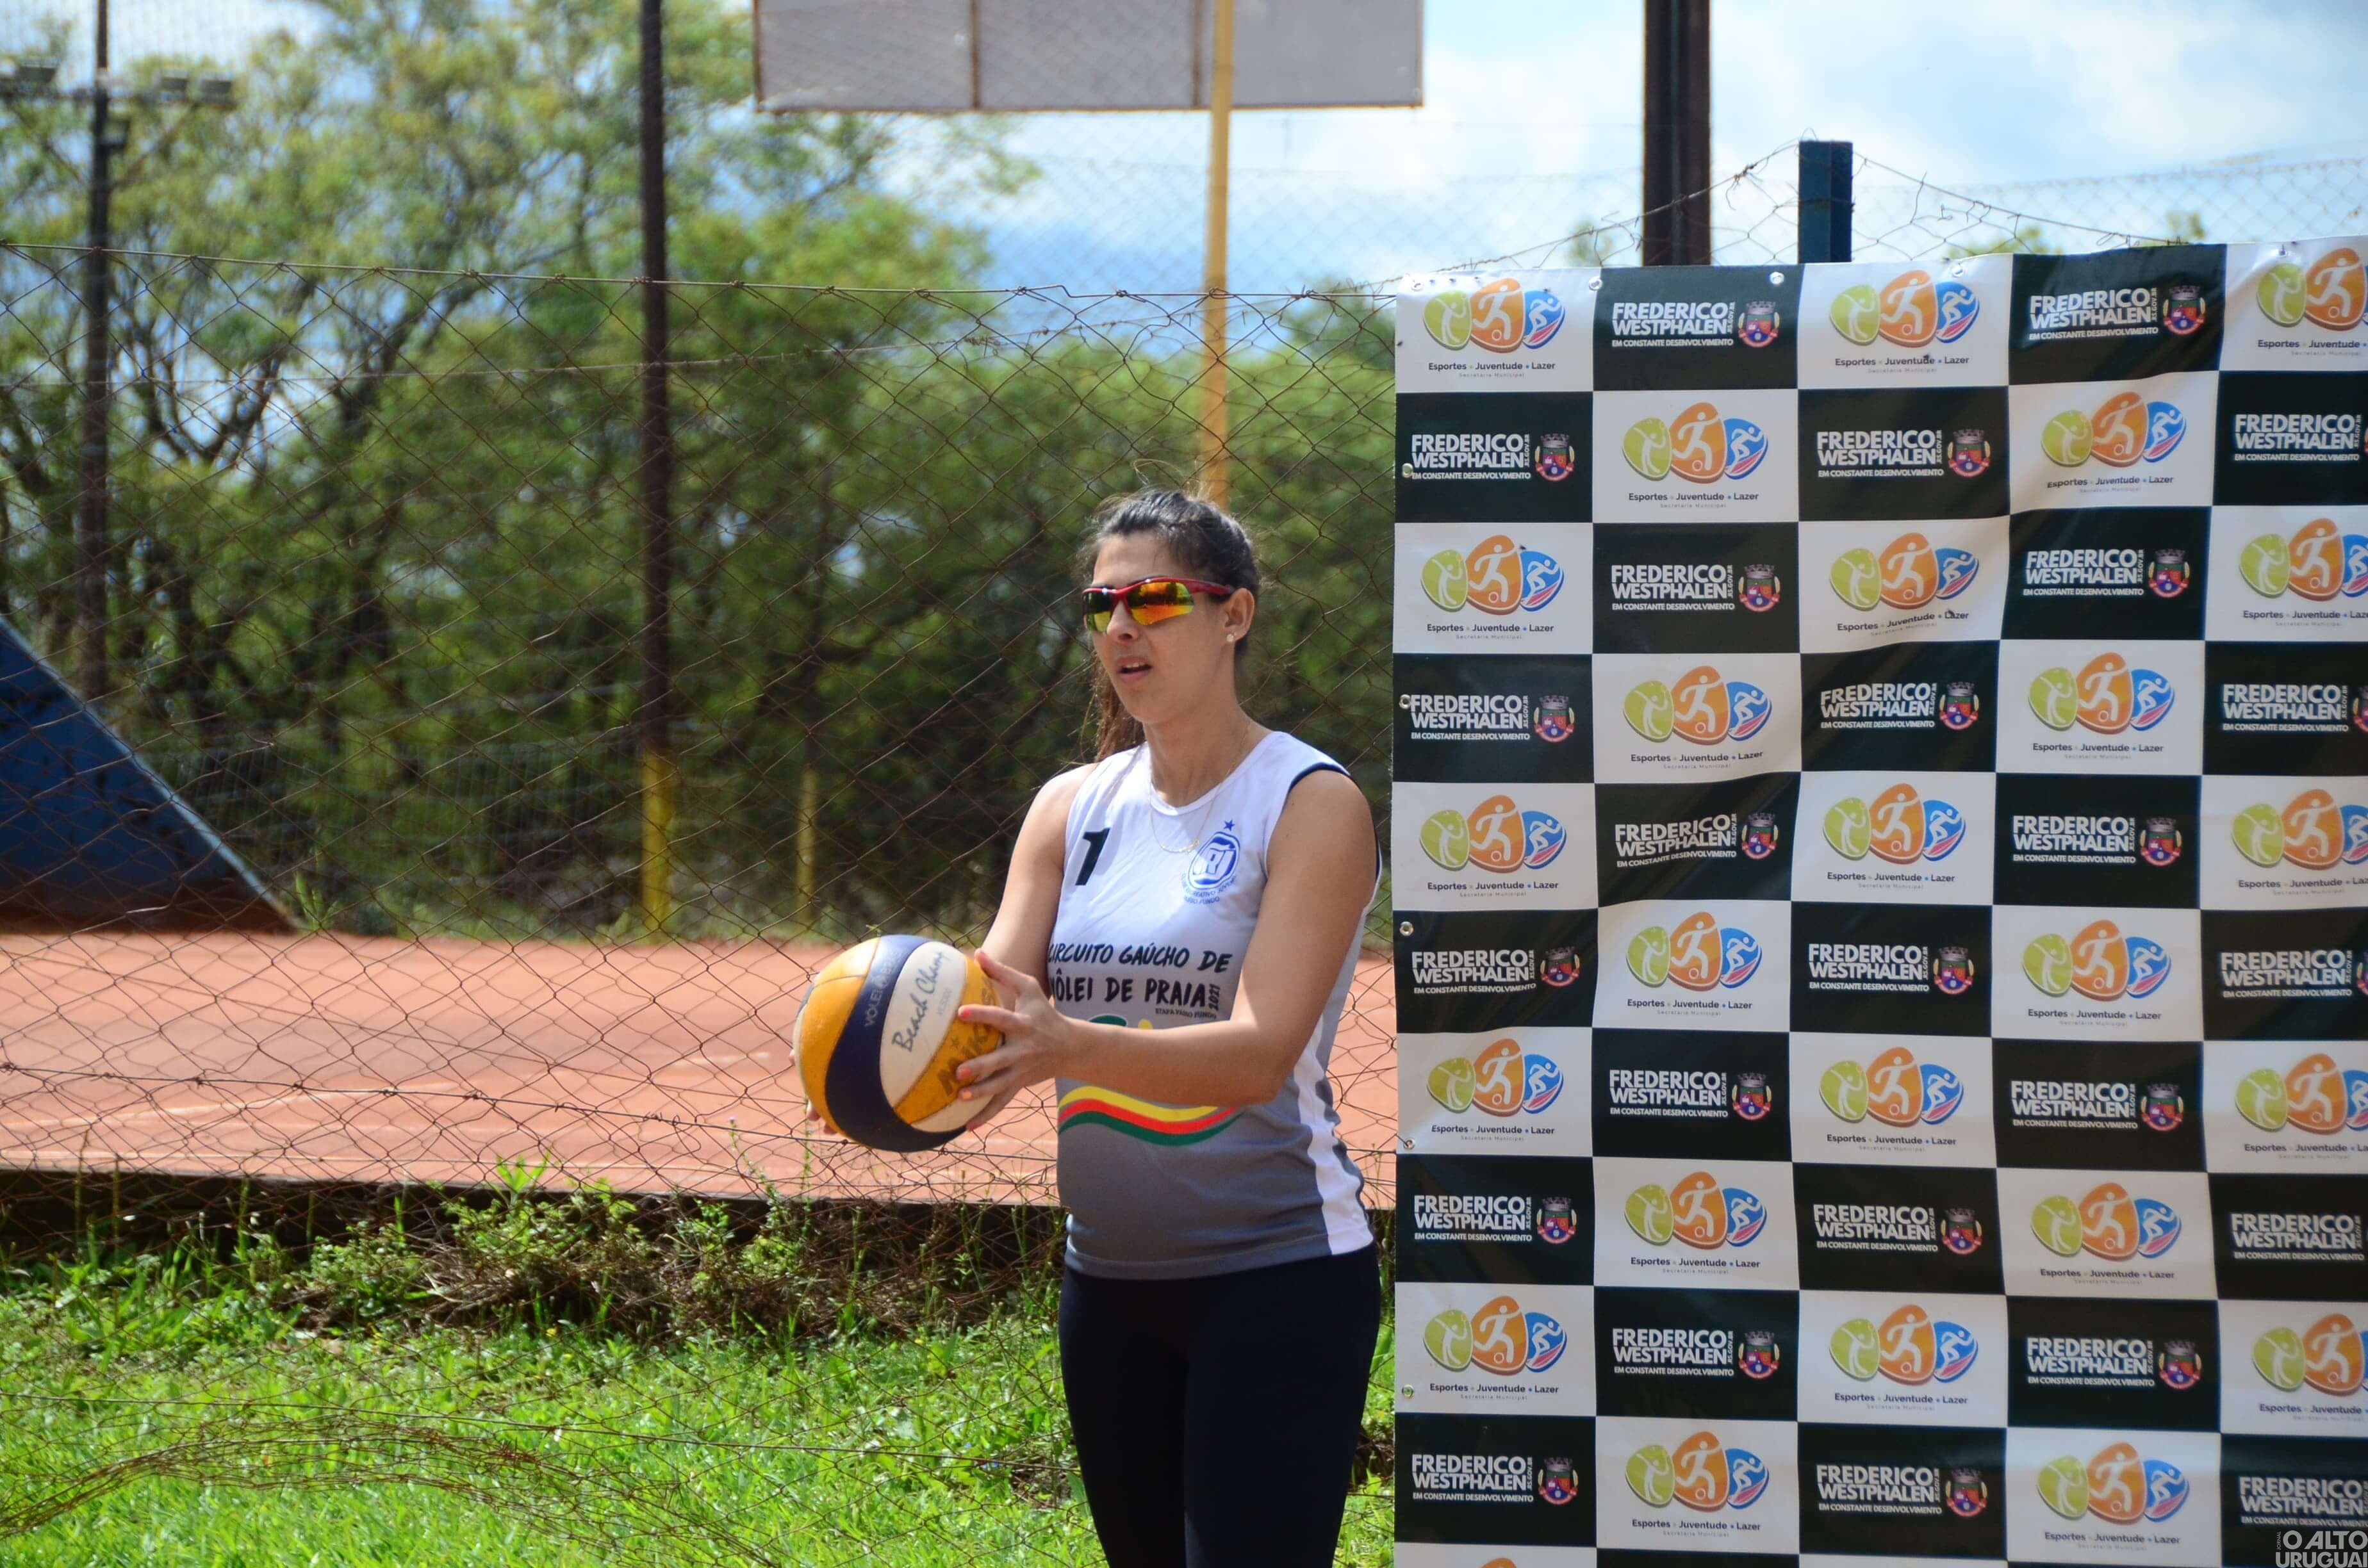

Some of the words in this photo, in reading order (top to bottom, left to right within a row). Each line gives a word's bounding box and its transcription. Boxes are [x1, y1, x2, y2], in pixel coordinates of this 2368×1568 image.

[2030, 288, 2150, 313] FREDERICO
[1612, 302, 1729, 320] FREDERICO
[2029, 306, 2151, 329] WESTPHALEN
[1611, 319, 1728, 336] WESTPHALEN
[1427, 363, 1467, 371] Esportes
[2235, 414, 2355, 433] FREDERICO
[1411, 434, 1524, 452] FREDERICO
[1817, 430, 1936, 450] FREDERICO
[2233, 432, 2355, 450] WESTPHALEN
[1411, 452, 1524, 468] WESTPHALEN
[1817, 448, 1936, 466] WESTPHALEN
[1629, 493, 1668, 502] Esportes
[2027, 549, 2137, 568] FREDERICO
[1611, 565, 1726, 583] FREDERICO
[2025, 567, 2137, 584] WESTPHALEN
[1611, 583, 1727, 599] WESTPHALEN
[1426, 624, 1465, 632] Esportes
[1821, 683, 1932, 702] FREDERICO
[2223, 684, 2340, 704] FREDERICO
[1411, 695, 1522, 713] FREDERICO
[1820, 701, 1930, 718] WESTPHALEN
[2223, 702, 2342, 720] WESTPHALEN
[1411, 712, 1523, 730] WESTPHALEN
[1462, 732, 1531, 740] DESENVOLVIMENTO
[2033, 743, 2073, 752] Esportes
[2081, 743, 2129, 751] Juventude
[1631, 755, 1671, 764] Esportes
[1679, 753, 1729, 761] Juventude
[1738, 752, 1764, 760] Lazer
[1615, 814, 1731, 842] FREDERICO
[2013, 815, 2128, 836] FREDERICO
[1616, 833, 1731, 858] WESTPHALEN
[2012, 833, 2129, 852] WESTPHALEN
[1075, 827, 1110, 886] 1
[2068, 854, 2136, 863] DESENVOLVIMENTO
[1827, 872, 1866, 881] Esportes
[1874, 873, 1921, 881] Juventude
[1427, 883, 1467, 891] Esportes
[1118, 942, 1190, 968] GAÚCHO
[1197, 951, 1233, 973] DE
[1411, 949, 1528, 968] FREDERICO
[1809, 943, 1921, 964] FREDERICO
[2221, 951, 2346, 970] FREDERICO
[1412, 966, 1529, 983] WESTPHALEN
[1809, 961, 1923, 980] WESTPHALEN
[2221, 968, 2346, 986] WESTPHALEN
[1104, 977, 1133, 1002] DE
[1144, 977, 1206, 1008] PRAIA
[1862, 983, 1930, 991] DESENVOLVIMENTO
[1208, 983, 1221, 1011] 2021
[1627, 999, 1665, 1008] Esportes
[1673, 1000, 1719, 1008] Juventude
[1728, 1001, 1752, 1009] Lazer
[891, 993, 929, 1052] Beach
[2028, 1009, 2068, 1018] Esportes
[2076, 1010, 2126, 1019] Juventude
[2135, 1011, 2161, 1020] Lazer
[1609, 1069, 1720, 1090] FREDERICO
[1609, 1087, 1722, 1106] WESTPHALEN
[2010, 1081, 2128, 1102] FREDERICO
[1662, 1108, 1729, 1117] DESENVOLVIMENTO
[2011, 1098, 2130, 1118] WESTPHALEN
[1431, 1125, 1468, 1134] Esportes
[1476, 1125, 1522, 1134] Juventude
[1827, 1134, 1866, 1143] Esportes
[1874, 1135, 1923, 1144] Juventude
[1932, 1137, 1957, 1145] Lazer
[1414, 1195, 1525, 1214] FREDERICO
[1415, 1213, 1525, 1230] WESTPHALEN
[1813, 1204, 1928, 1225] FREDERICO
[2231, 1213, 2354, 1233] FREDERICO
[1467, 1233, 1533, 1241] DESENVOLVIMENTO
[1814, 1221, 1930, 1241] WESTPHALEN
[2232, 1231, 2356, 1249] WESTPHALEN
[1631, 1257, 1670, 1266] Esportes
[1679, 1258, 1727, 1267] Juventude
[2040, 1269, 2082, 1278] Esportes
[2089, 1270, 2140, 1278] Juventude
[1613, 1328, 1727, 1349] FREDERICO
[1613, 1346, 1727, 1365] WESTPHALEN
[2027, 1337, 2146, 1359] FREDERICO
[2027, 1355, 2148, 1375] WESTPHALEN
[1429, 1384, 1469, 1392] Esportes
[1477, 1384, 1525, 1392] Juventude
[2084, 1377, 2155, 1386] DESENVOLVIMENTO
[1411, 1454, 1526, 1474] FREDERICO
[1411, 1472, 1527, 1491] WESTPHALEN
[1816, 1464, 1933, 1487] FREDERICO
[1817, 1483, 1934, 1503] WESTPHALEN
[2239, 1476, 2362, 1499] FREDERICO
[1465, 1493, 1534, 1502] DESENVOLVIMENTO
[2240, 1495, 2364, 1515] WESTPHALEN
[1632, 1519, 1671, 1529] Esportes
[1679, 1520, 1727, 1530] Juventude
[1736, 1522, 1761, 1531] Lazer
